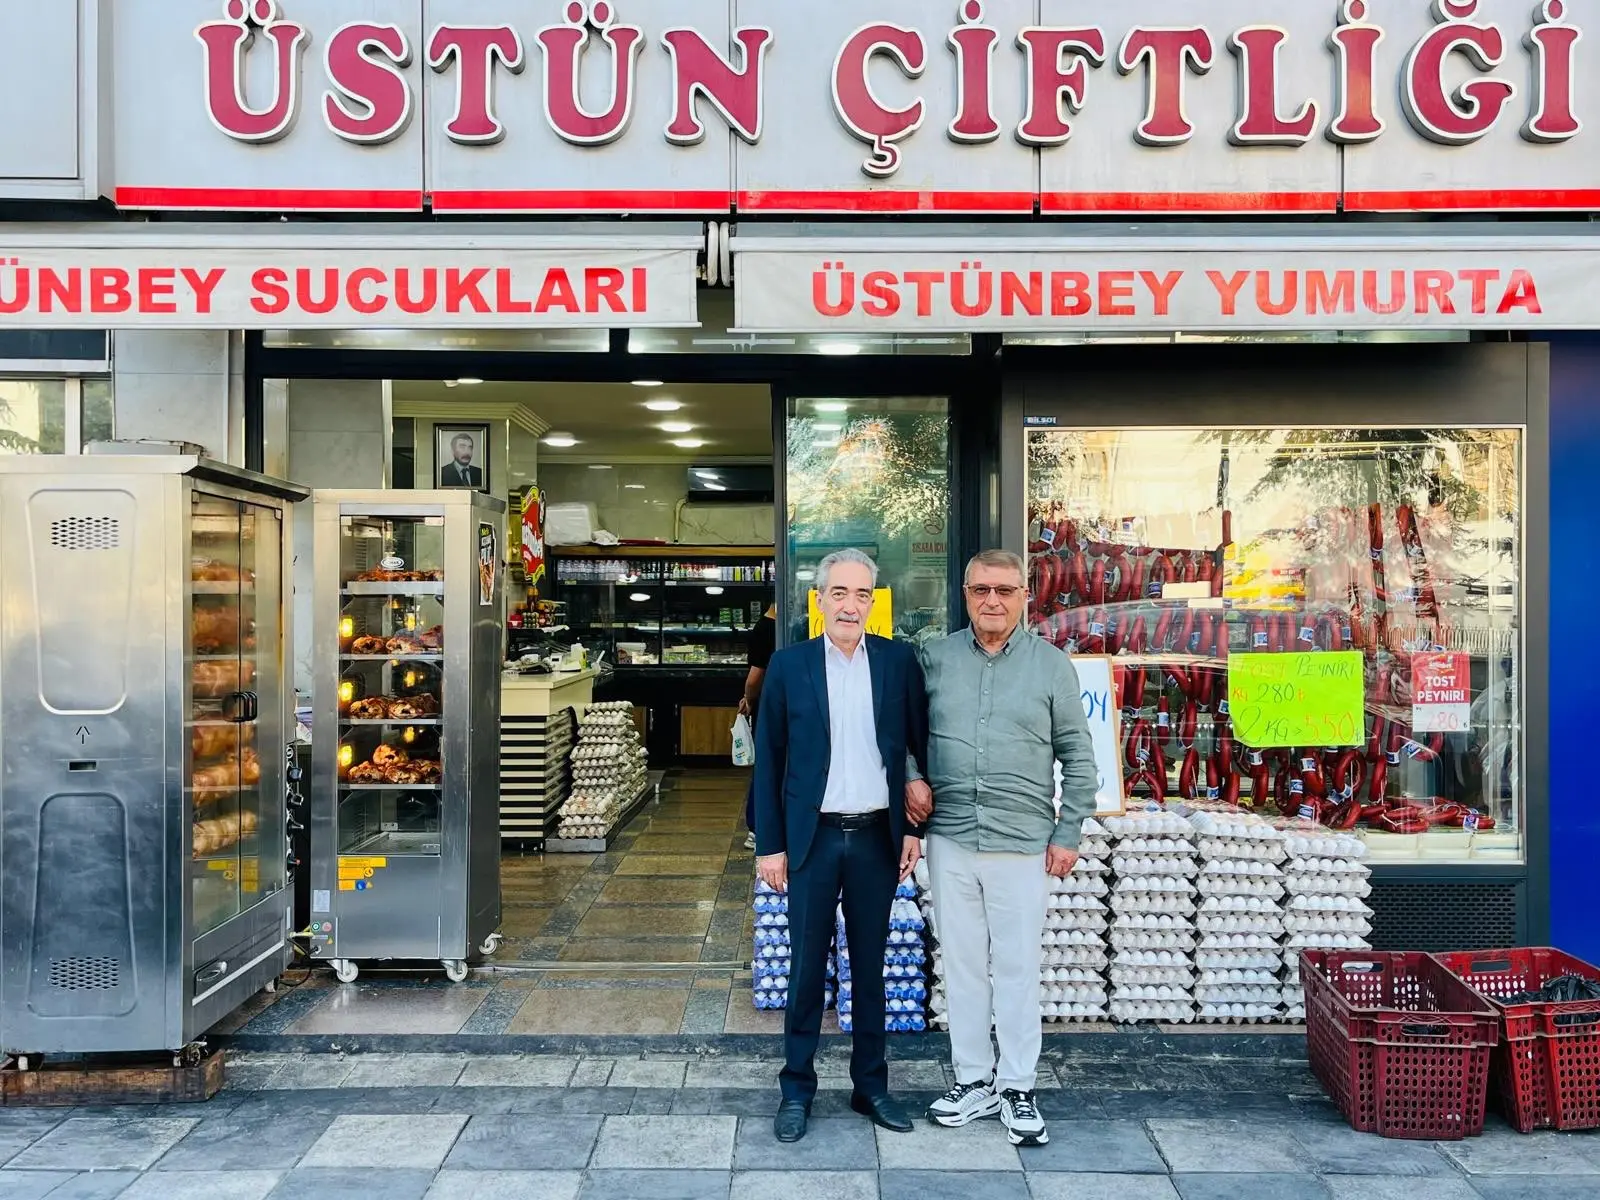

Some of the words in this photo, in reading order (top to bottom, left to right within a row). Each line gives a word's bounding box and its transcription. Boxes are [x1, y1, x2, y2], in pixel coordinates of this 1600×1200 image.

[194, 0, 774, 145] ÜSTÜN
[831, 0, 1584, 178] ÇİFTLİĞİ
[249, 266, 648, 315] SUCUKLARI
[811, 260, 1183, 317] ÜSTÜNBEY
[1205, 268, 1542, 316] YUMURTA
[1417, 689, 1465, 702] PEYNİRİ
[1425, 676, 1457, 688] TOST
